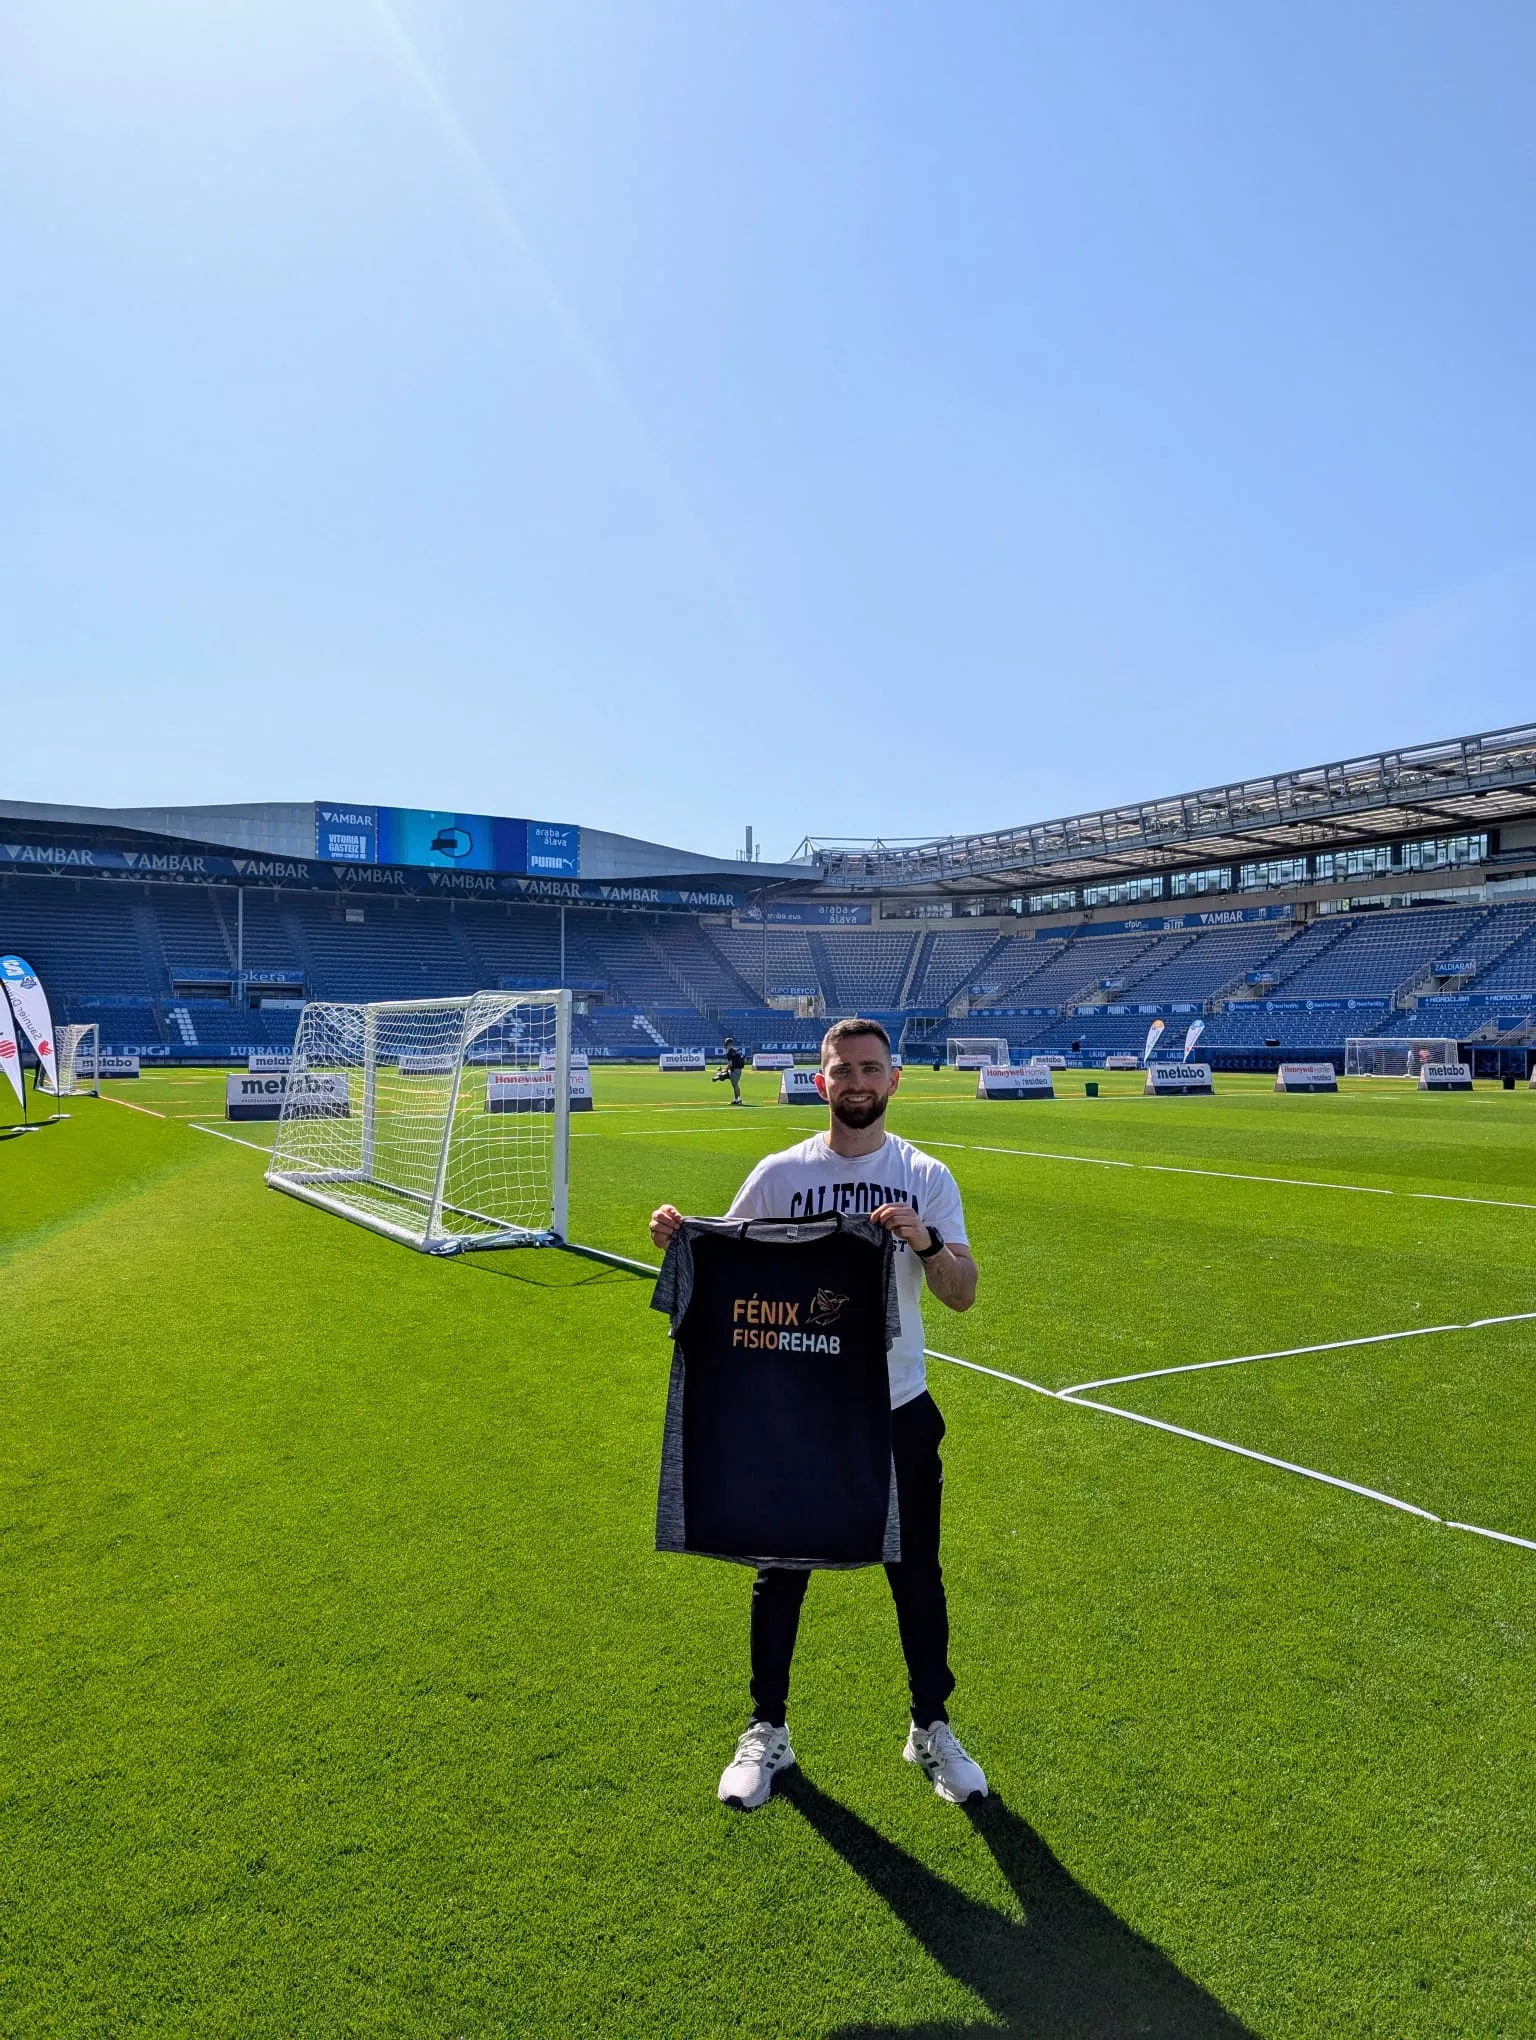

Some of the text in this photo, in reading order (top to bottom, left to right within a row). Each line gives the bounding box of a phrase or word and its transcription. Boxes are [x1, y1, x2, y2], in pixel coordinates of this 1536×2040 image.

[330, 813, 373, 826] AMBAR
[535, 827, 560, 838] araba
[328, 834, 359, 845] VITORIA
[328, 843, 360, 854] GASTEIZ
[21, 847, 95, 866] AMBAR
[138, 854, 207, 872] AMBAR
[531, 856, 563, 869] PUMA
[245, 860, 310, 879] AMBAR
[346, 867, 406, 885] AMBAR
[441, 873, 496, 890] AMBAR
[528, 880, 582, 897] AMBAR
[611, 887, 660, 903] AMBAR
[689, 893, 735, 907] AMBAR
[818, 905, 848, 914] araba
[1207, 911, 1244, 924] AMBAR
[123, 1045, 170, 1056] DIGI
[229, 1046, 302, 1056] LURRALD
[666, 1054, 701, 1063] metabo
[986, 1068, 1025, 1078] Honeywell
[1157, 1066, 1205, 1079] metabo
[1428, 1065, 1464, 1076] metabo
[495, 1074, 552, 1086] Honeywell
[733, 1292, 799, 1326] FÉNIX
[732, 1328, 841, 1355] FISIOREHAB
